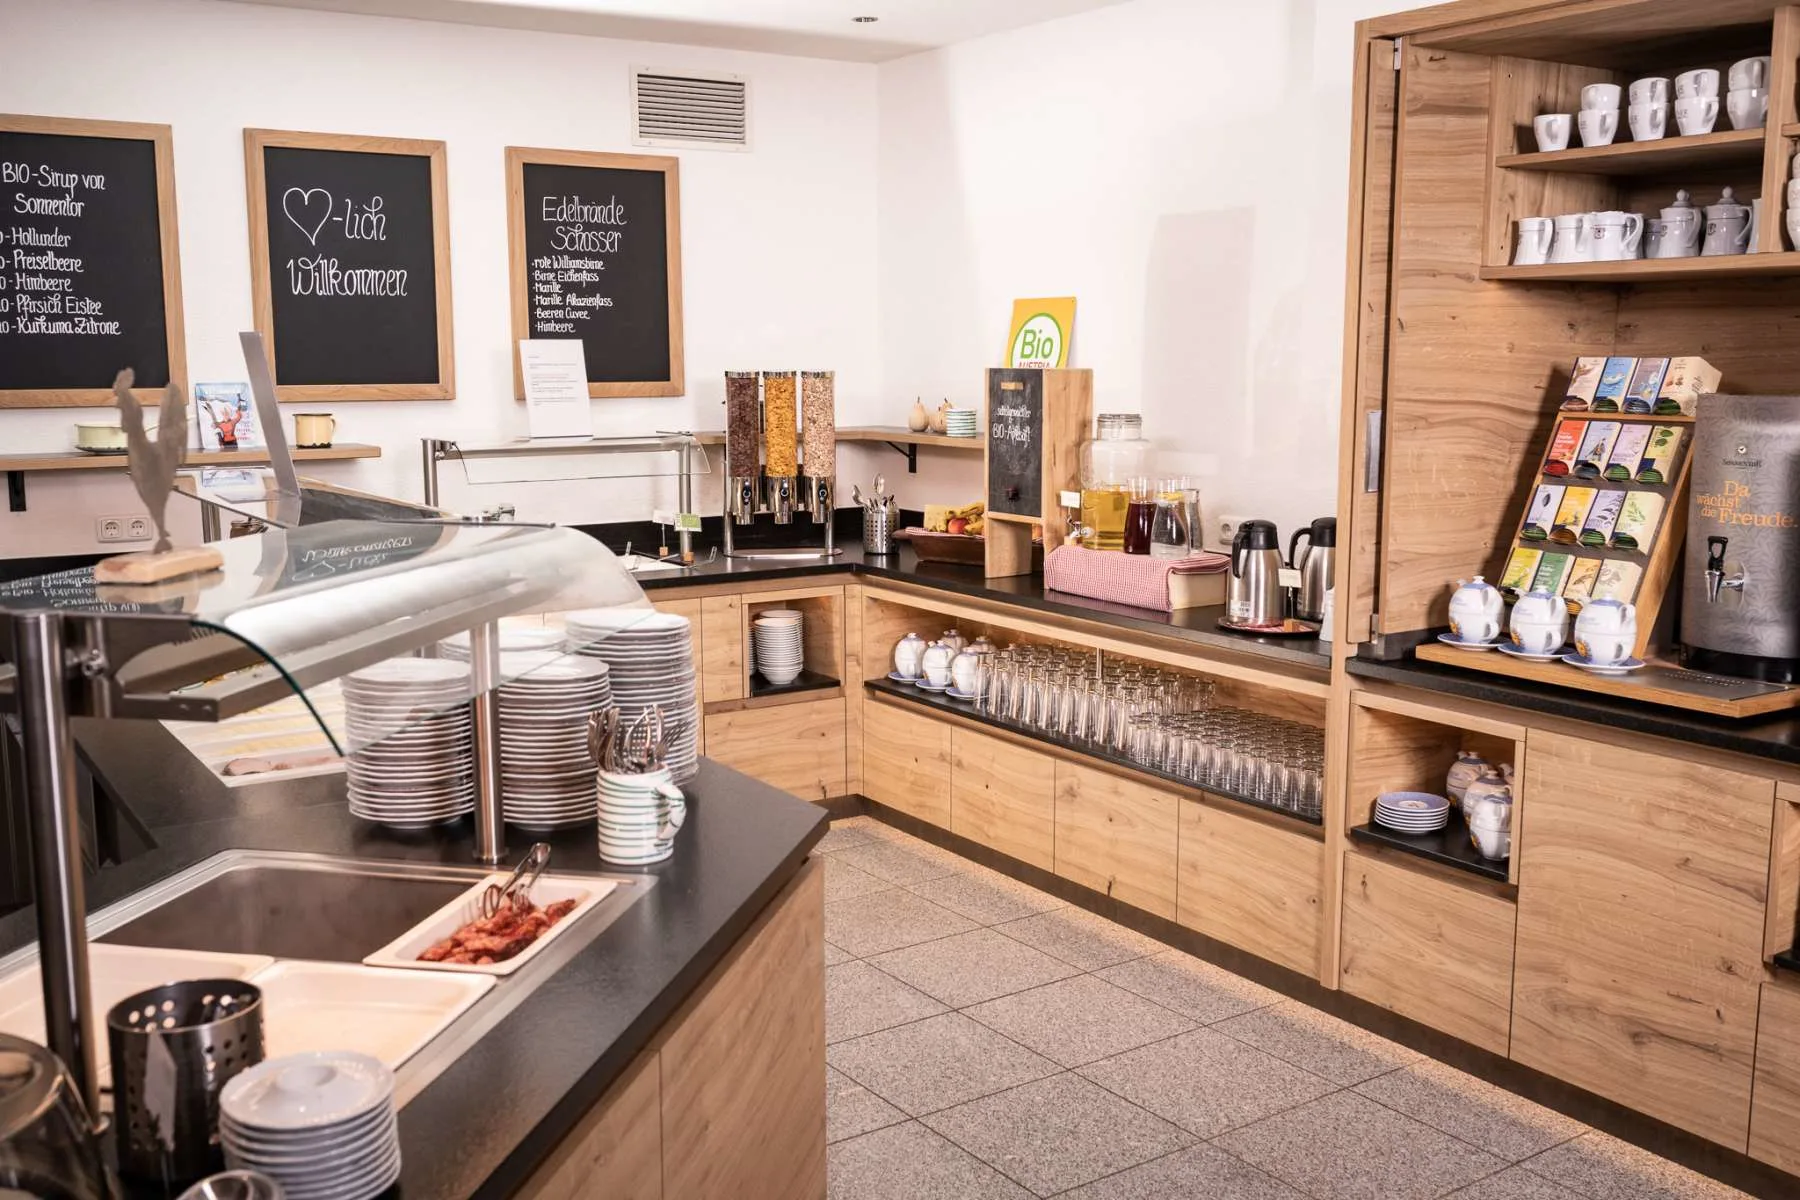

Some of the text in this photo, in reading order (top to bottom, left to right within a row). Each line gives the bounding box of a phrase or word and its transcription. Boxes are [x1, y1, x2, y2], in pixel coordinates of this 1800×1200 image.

[81, 174, 106, 190] von
[14, 193, 85, 217] Sonnentor
[542, 195, 628, 225] Edelbrände
[286, 253, 408, 297] Willkommen
[65, 296, 103, 315] Eistee
[73, 317, 122, 335] Zitrone
[1020, 328, 1054, 360] Bio
